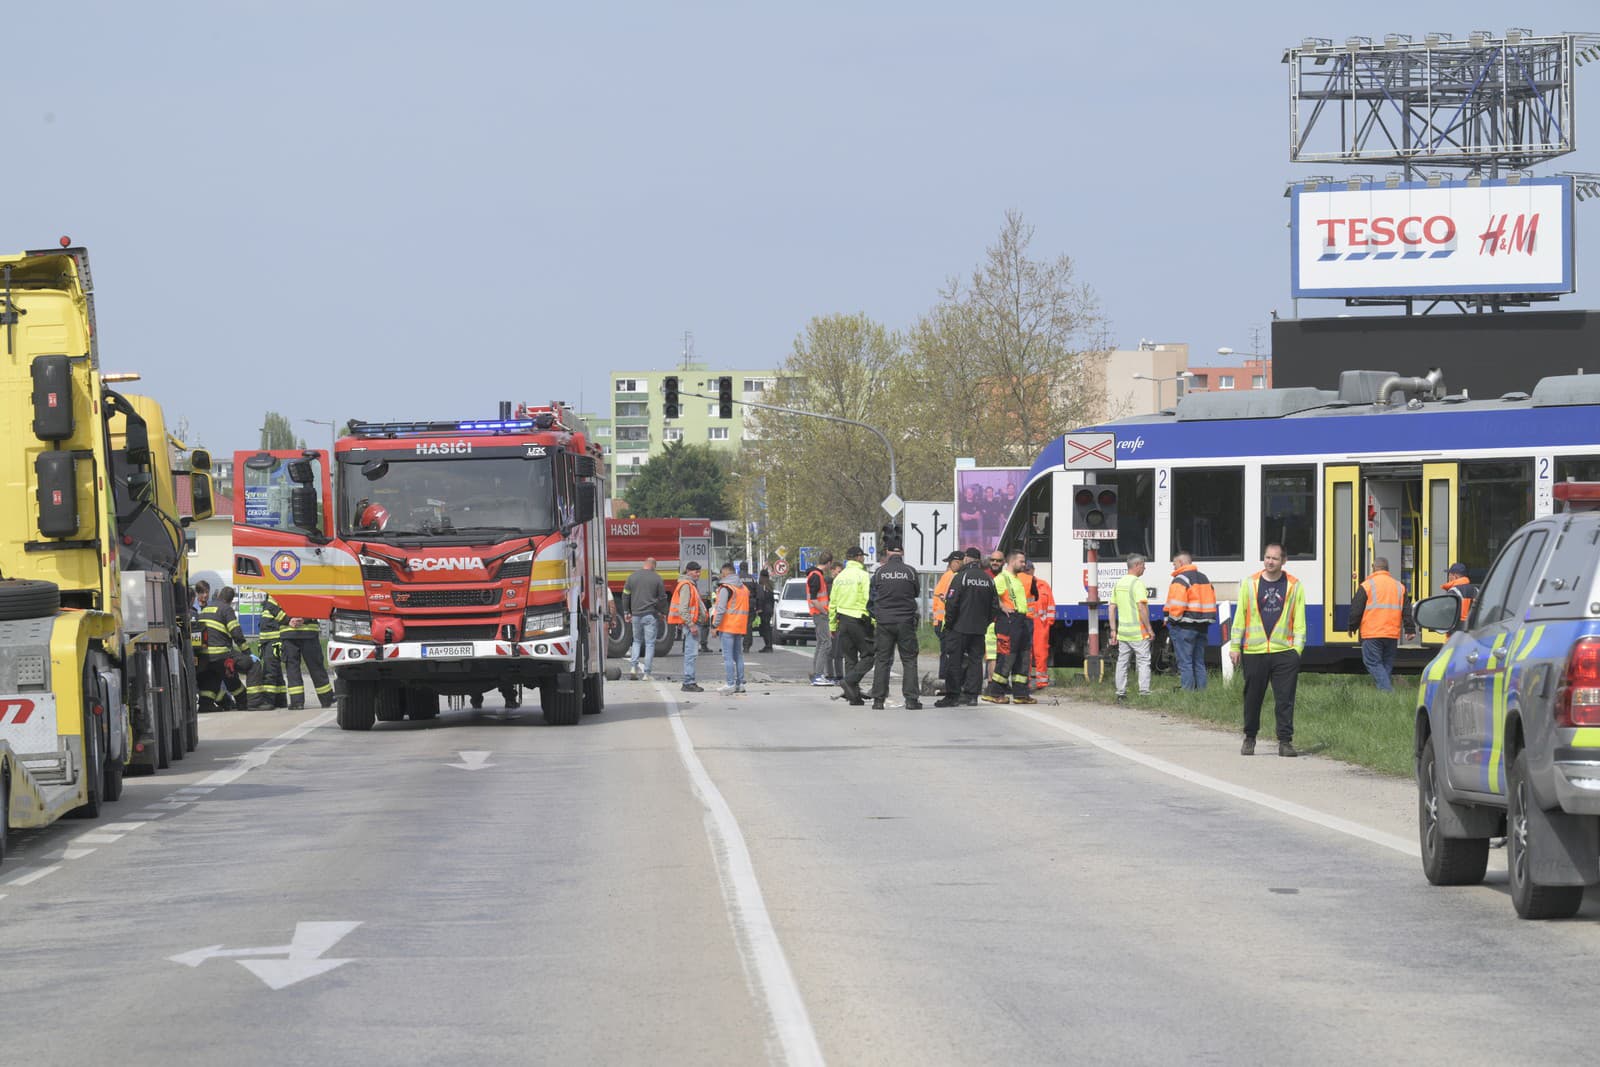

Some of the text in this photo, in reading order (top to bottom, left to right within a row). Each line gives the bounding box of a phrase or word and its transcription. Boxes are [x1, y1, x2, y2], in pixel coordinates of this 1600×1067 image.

[1316, 213, 1540, 257] TESCO H&M
[416, 440, 472, 455] HASIČI
[1116, 435, 1145, 454] renfe
[1539, 457, 1549, 479] 2
[1159, 469, 1167, 489] 2
[610, 521, 640, 536] HASIČI
[1099, 530, 1115, 538] VLAK
[692, 543, 706, 556] 150
[407, 556, 486, 571] SCANIA
[880, 571, 908, 580] POLÍCIA
[1097, 567, 1128, 576] MINISTERST
[967, 578, 989, 587] POLÍCIA
[428, 647, 440, 656] AA
